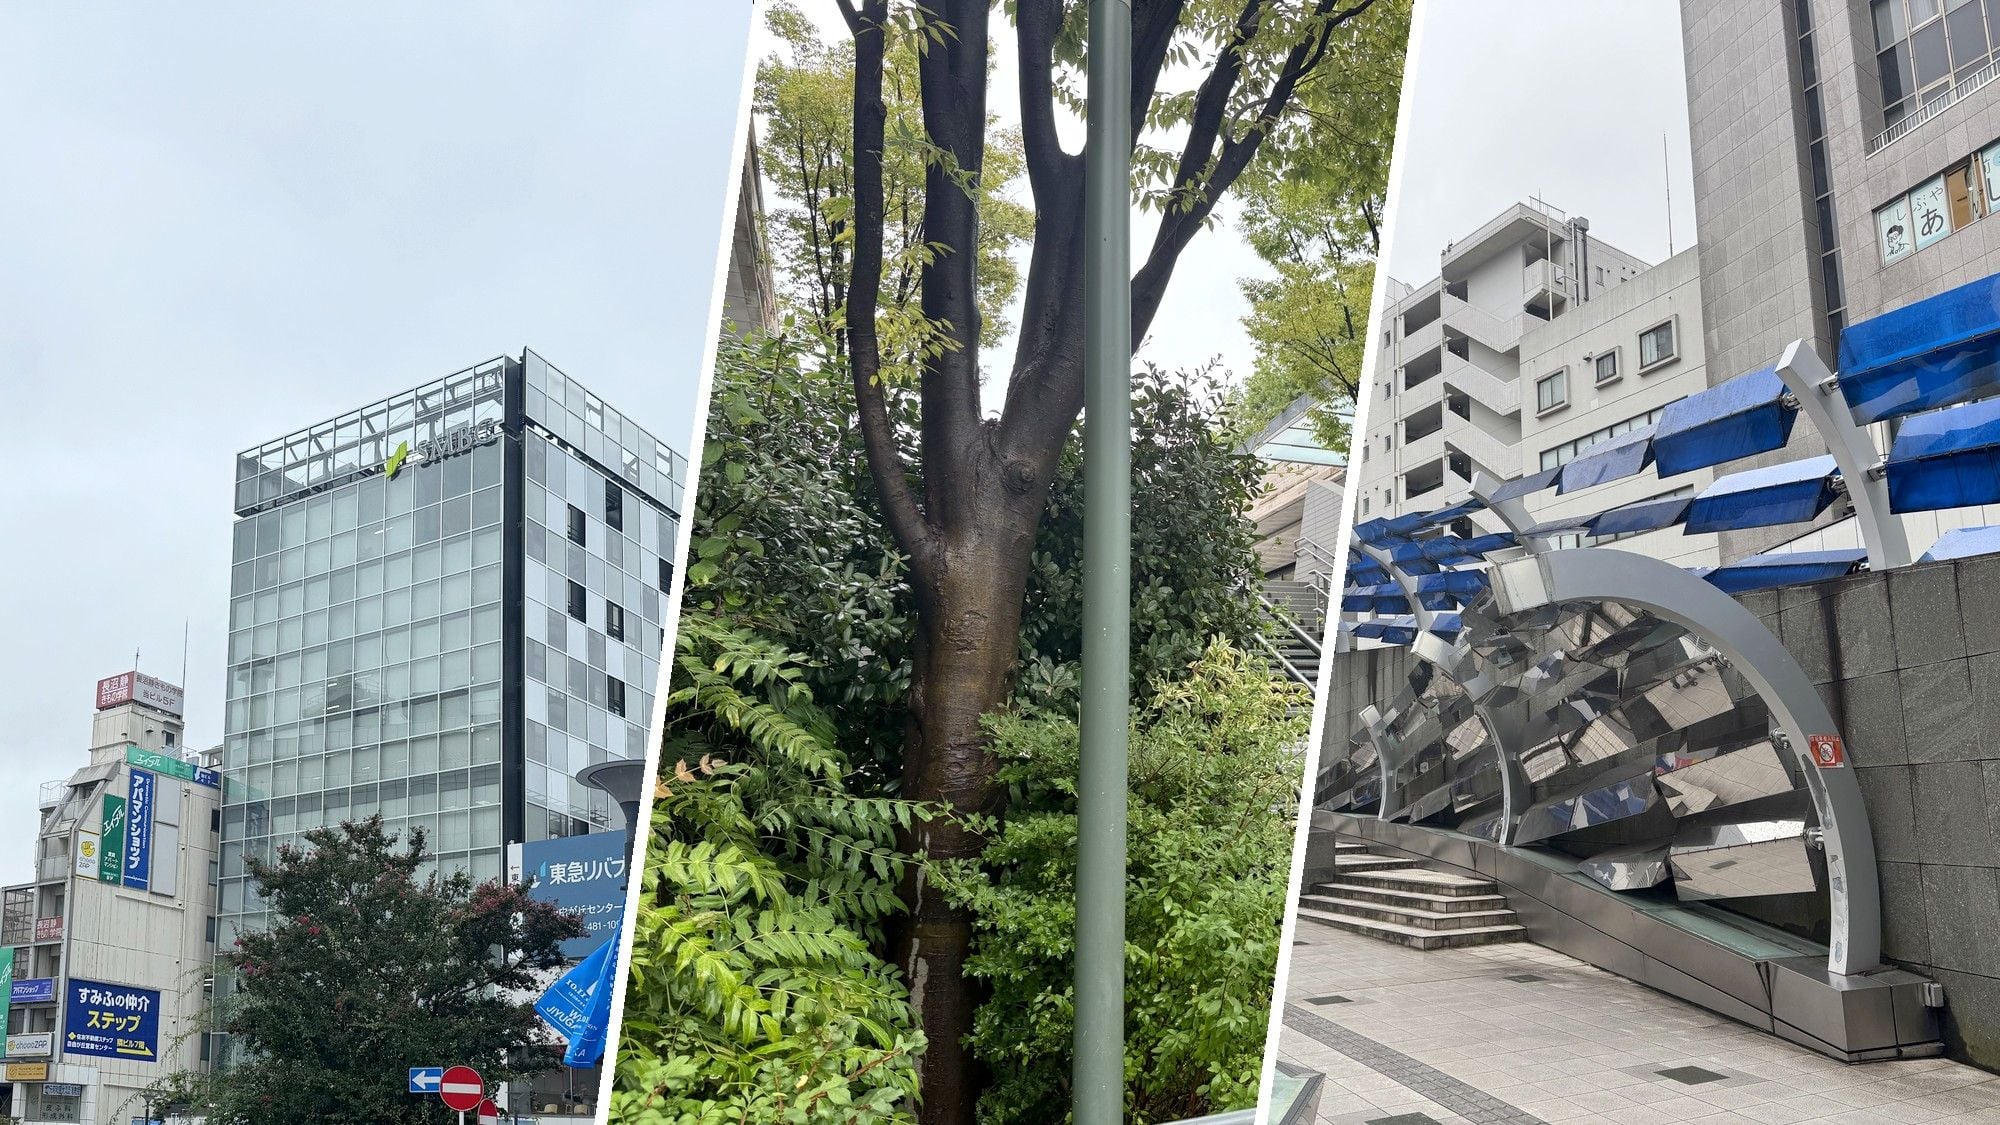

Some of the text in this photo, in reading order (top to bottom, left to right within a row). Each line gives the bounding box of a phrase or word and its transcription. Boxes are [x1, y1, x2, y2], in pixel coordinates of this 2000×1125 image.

[1920, 208, 1944, 237] あ
[417, 417, 495, 464] SMBC
[129, 775, 144, 869] アパマンショップ
[78, 987, 150, 1013] すみふの仲介
[86, 1010, 141, 1033] ステップ
